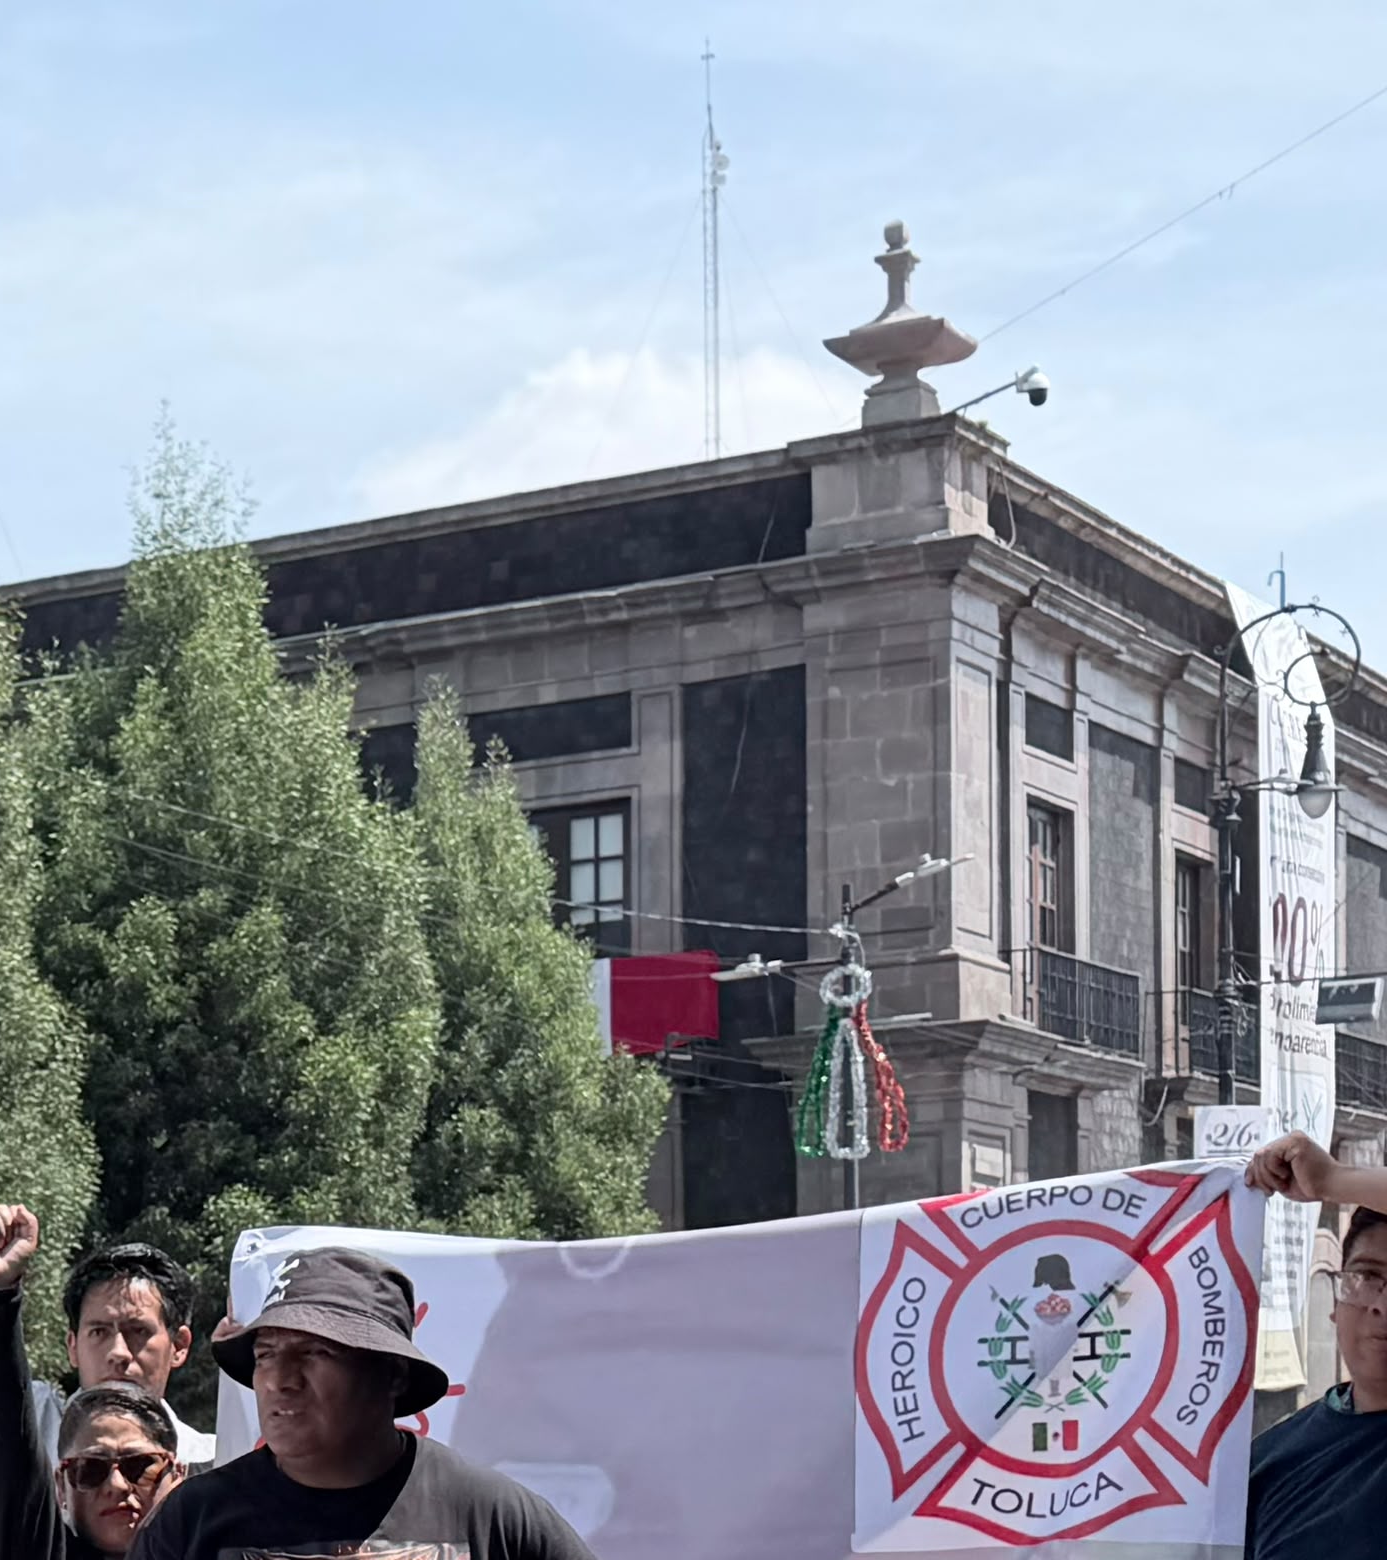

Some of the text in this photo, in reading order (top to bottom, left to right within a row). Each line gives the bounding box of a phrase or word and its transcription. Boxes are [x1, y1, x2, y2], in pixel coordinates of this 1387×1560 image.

[959, 1184, 1147, 1230] CUERPO DE
[891, 1276, 927, 1443] HEROICO
[1176, 1245, 1226, 1427] BOMBEROS
[970, 1471, 1124, 1519] TOLUCA
